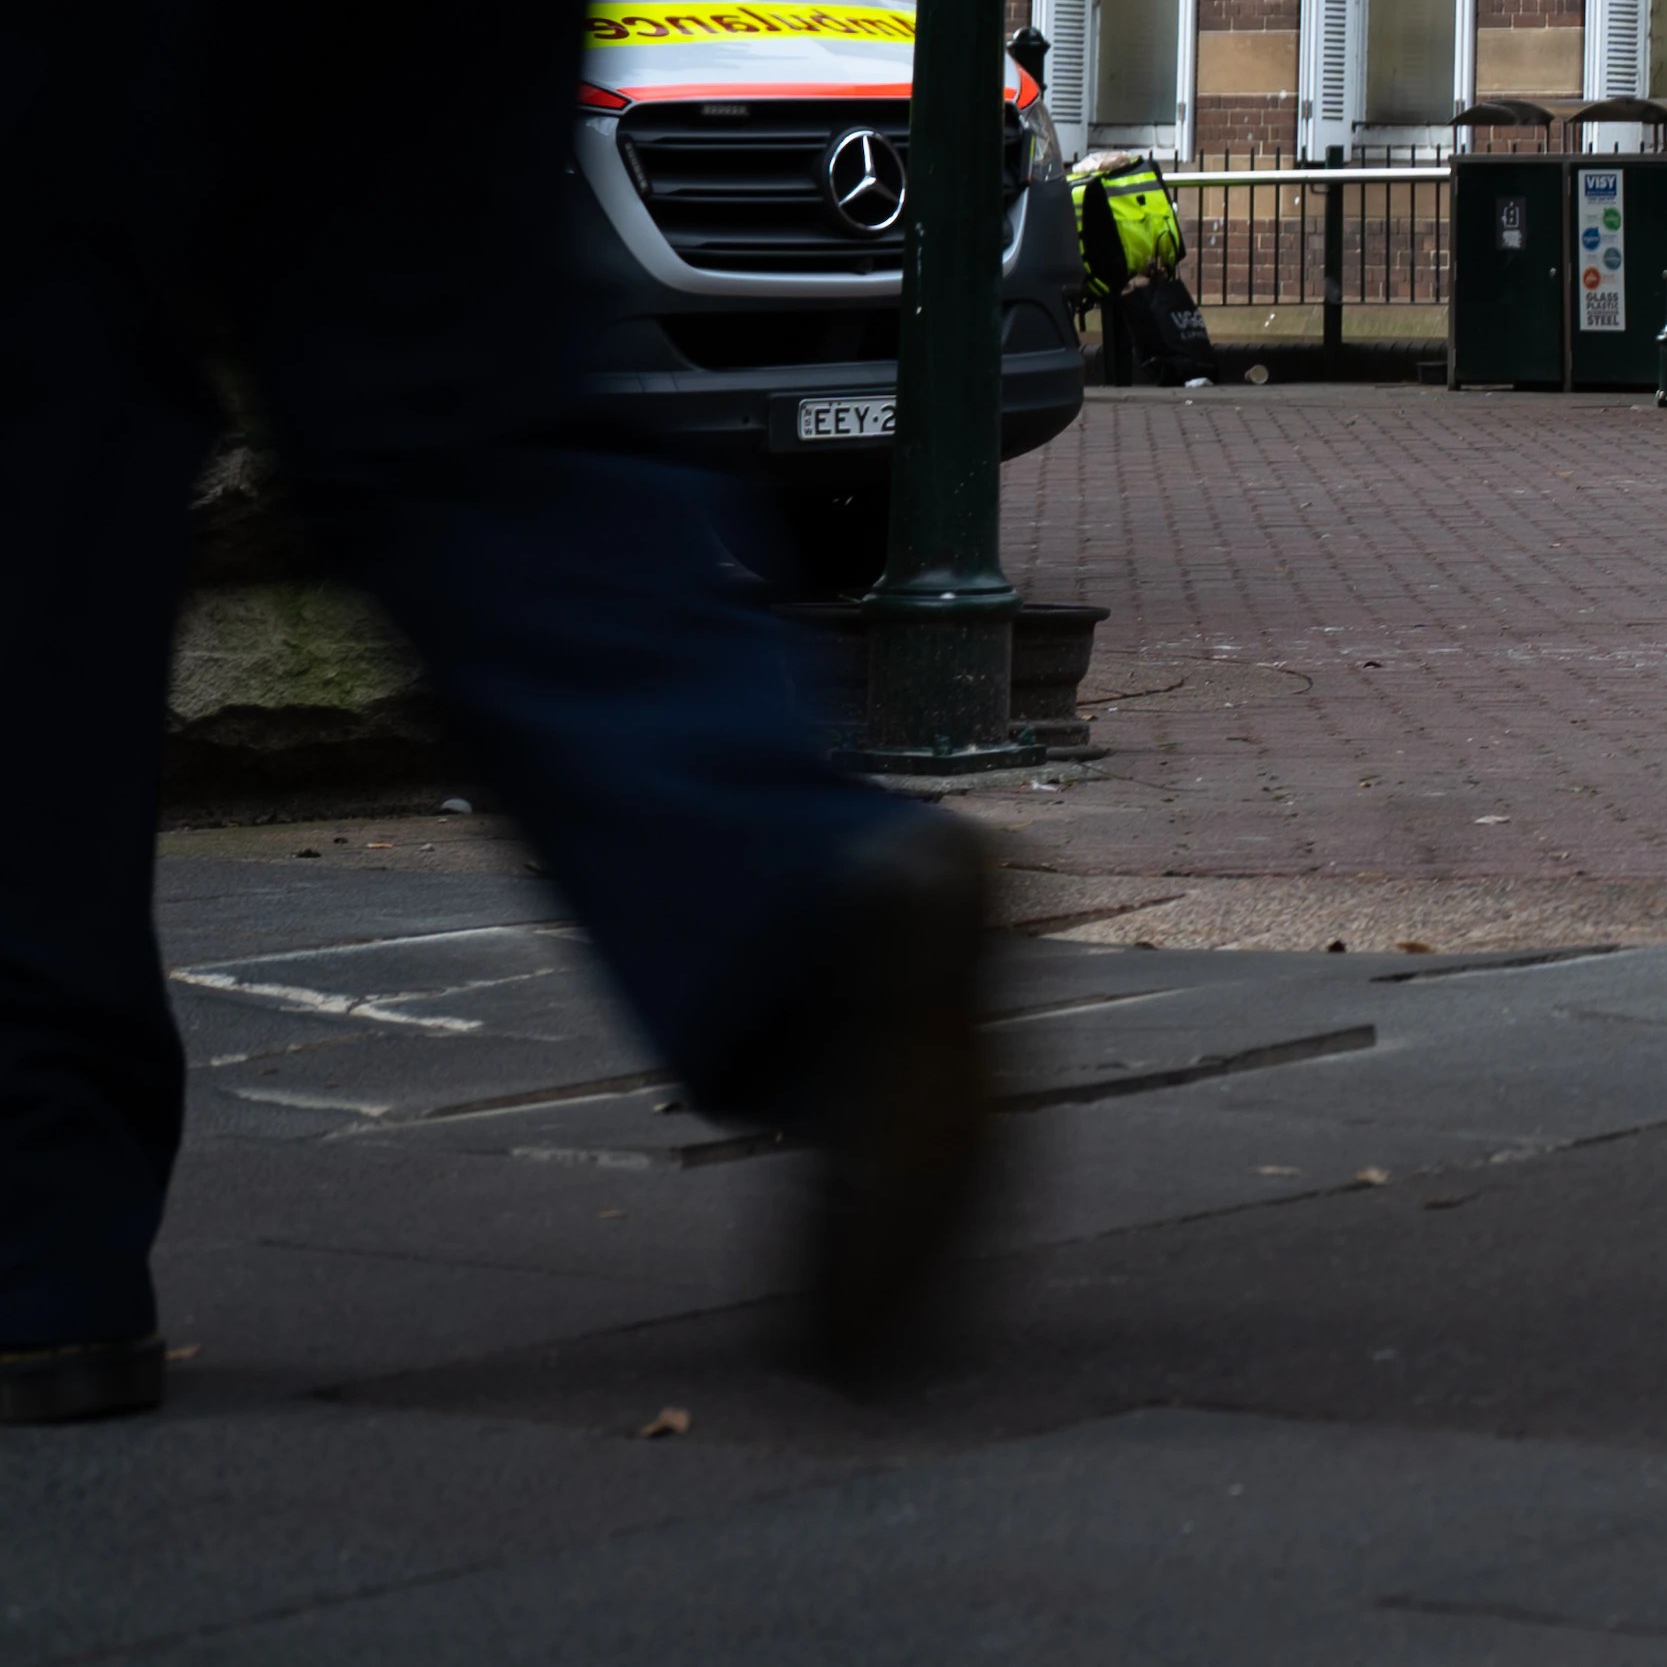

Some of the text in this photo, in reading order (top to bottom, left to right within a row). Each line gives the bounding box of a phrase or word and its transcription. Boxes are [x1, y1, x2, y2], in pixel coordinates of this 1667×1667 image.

[1586, 175, 1616, 189] VISY
[1586, 292, 1618, 302] GLASS
[1587, 315, 1620, 326] STEEL
